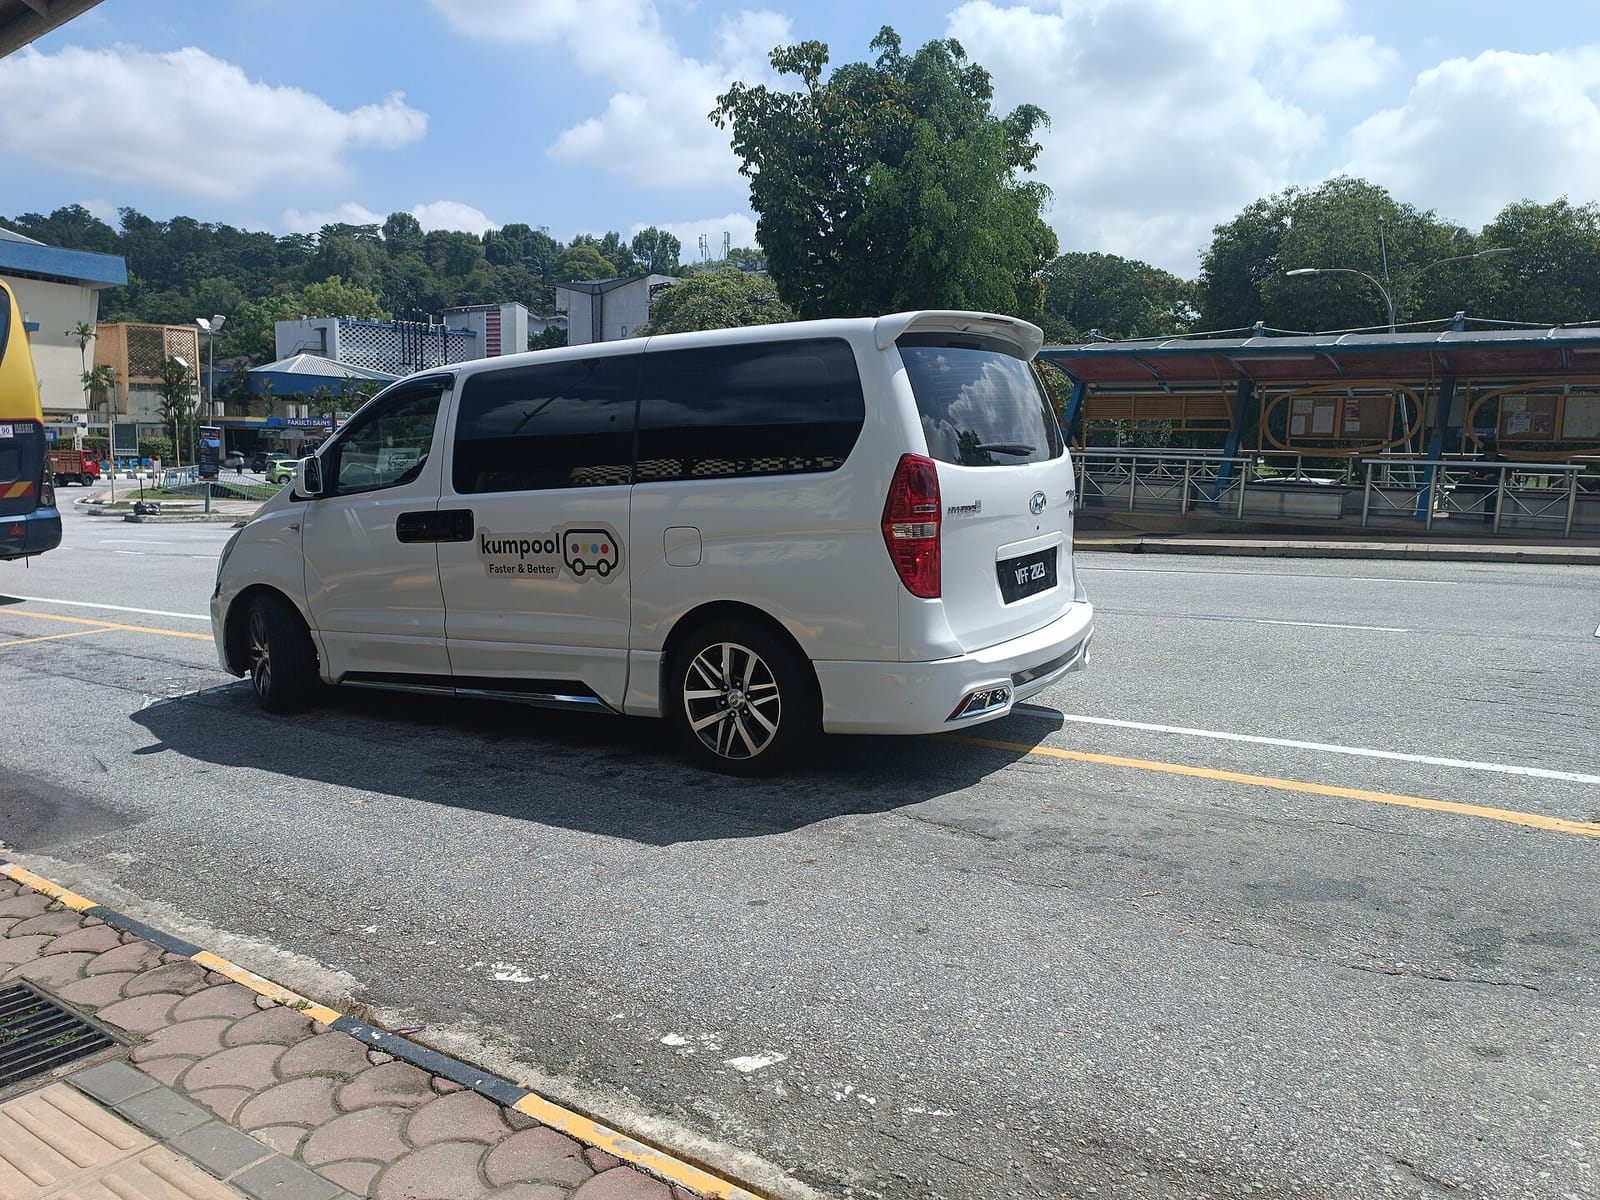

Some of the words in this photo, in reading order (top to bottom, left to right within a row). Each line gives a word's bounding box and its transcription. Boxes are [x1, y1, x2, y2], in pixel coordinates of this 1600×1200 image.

[481, 533, 560, 559] kumpool
[489, 564, 516, 574] Faster
[518, 564, 525, 573] &
[527, 564, 555, 574] Better
[1015, 566, 1029, 584] VFF
